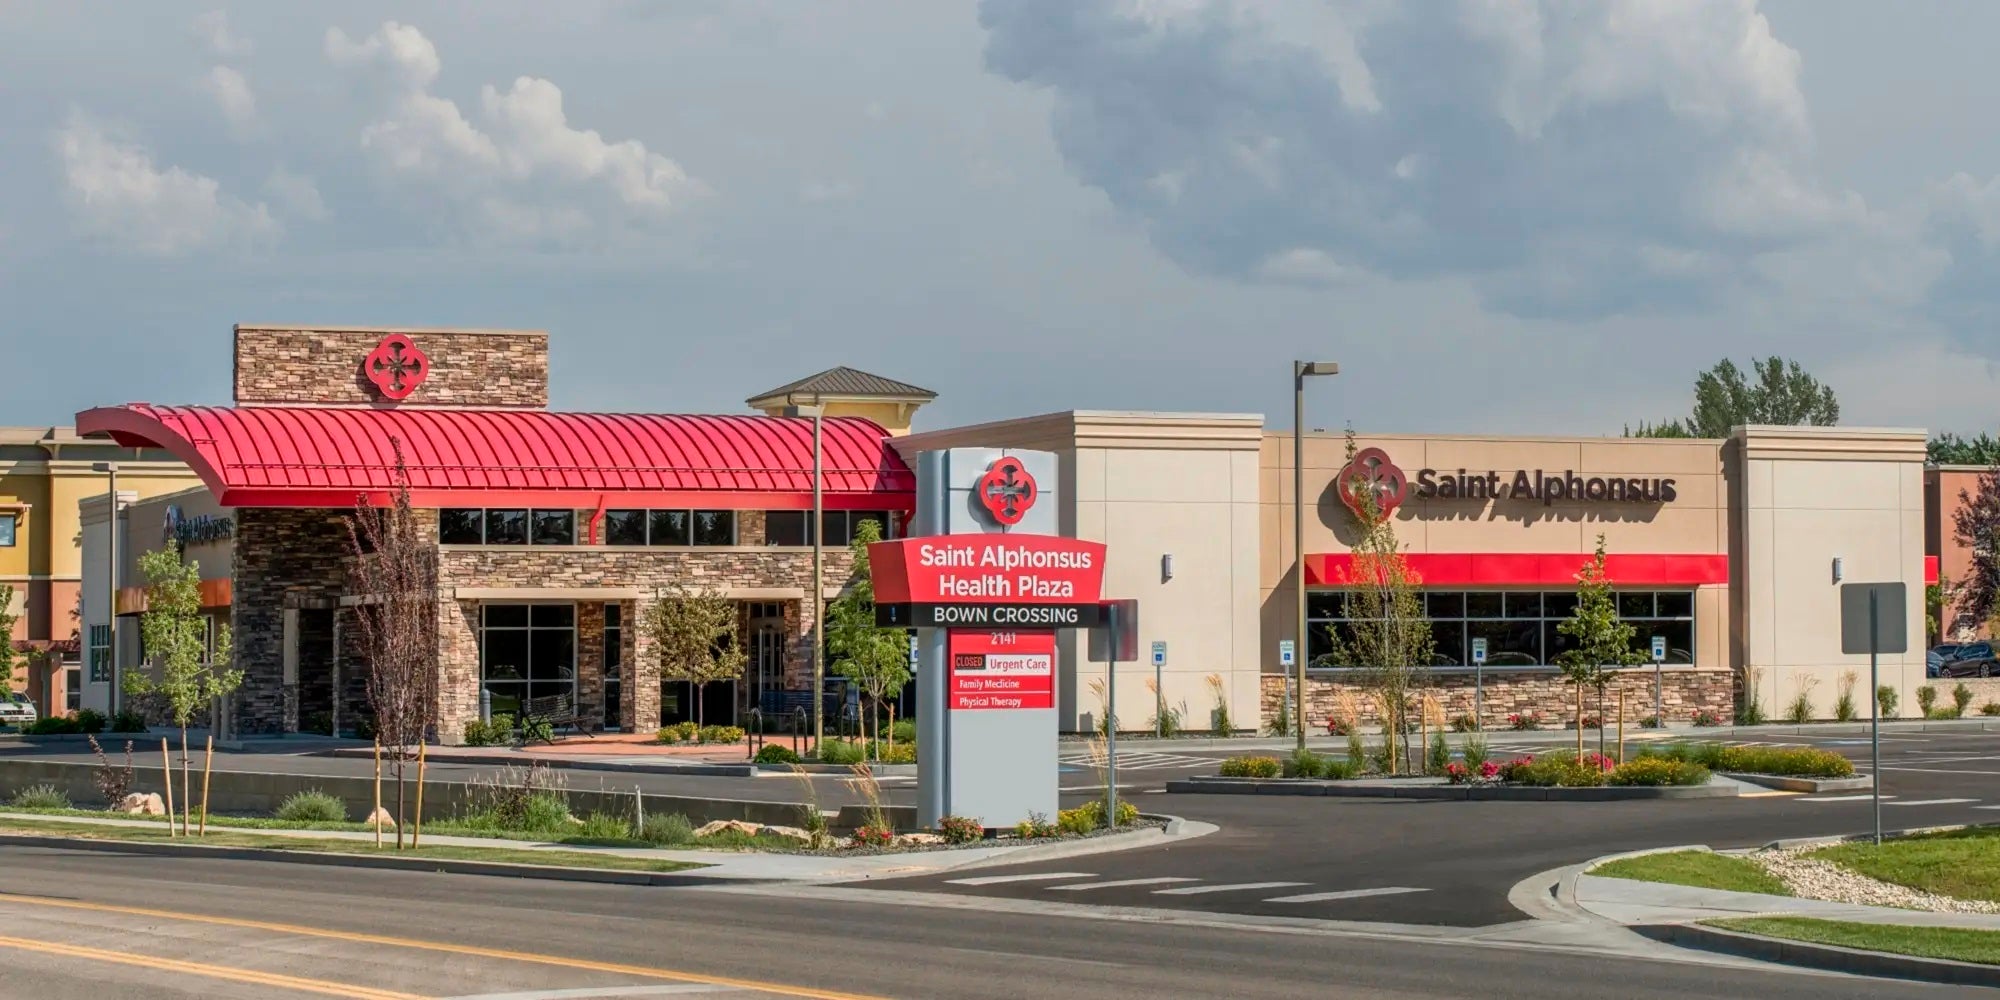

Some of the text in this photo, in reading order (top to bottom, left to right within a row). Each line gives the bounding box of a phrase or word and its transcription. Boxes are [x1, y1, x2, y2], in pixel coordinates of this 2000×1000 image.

[1416, 468, 1676, 506] Saint Alphonsus
[920, 545, 1092, 571] Saint Alphonsus
[939, 574, 1073, 597] Health Plaza
[934, 607, 1078, 623] BOWN CROSSING
[990, 632, 1016, 645] 2141
[955, 656, 983, 667] CLOSED
[990, 659, 1047, 672] Urgent Care
[959, 679, 1020, 691] Family Medicine
[959, 697, 1022, 708] Physical Therapy
